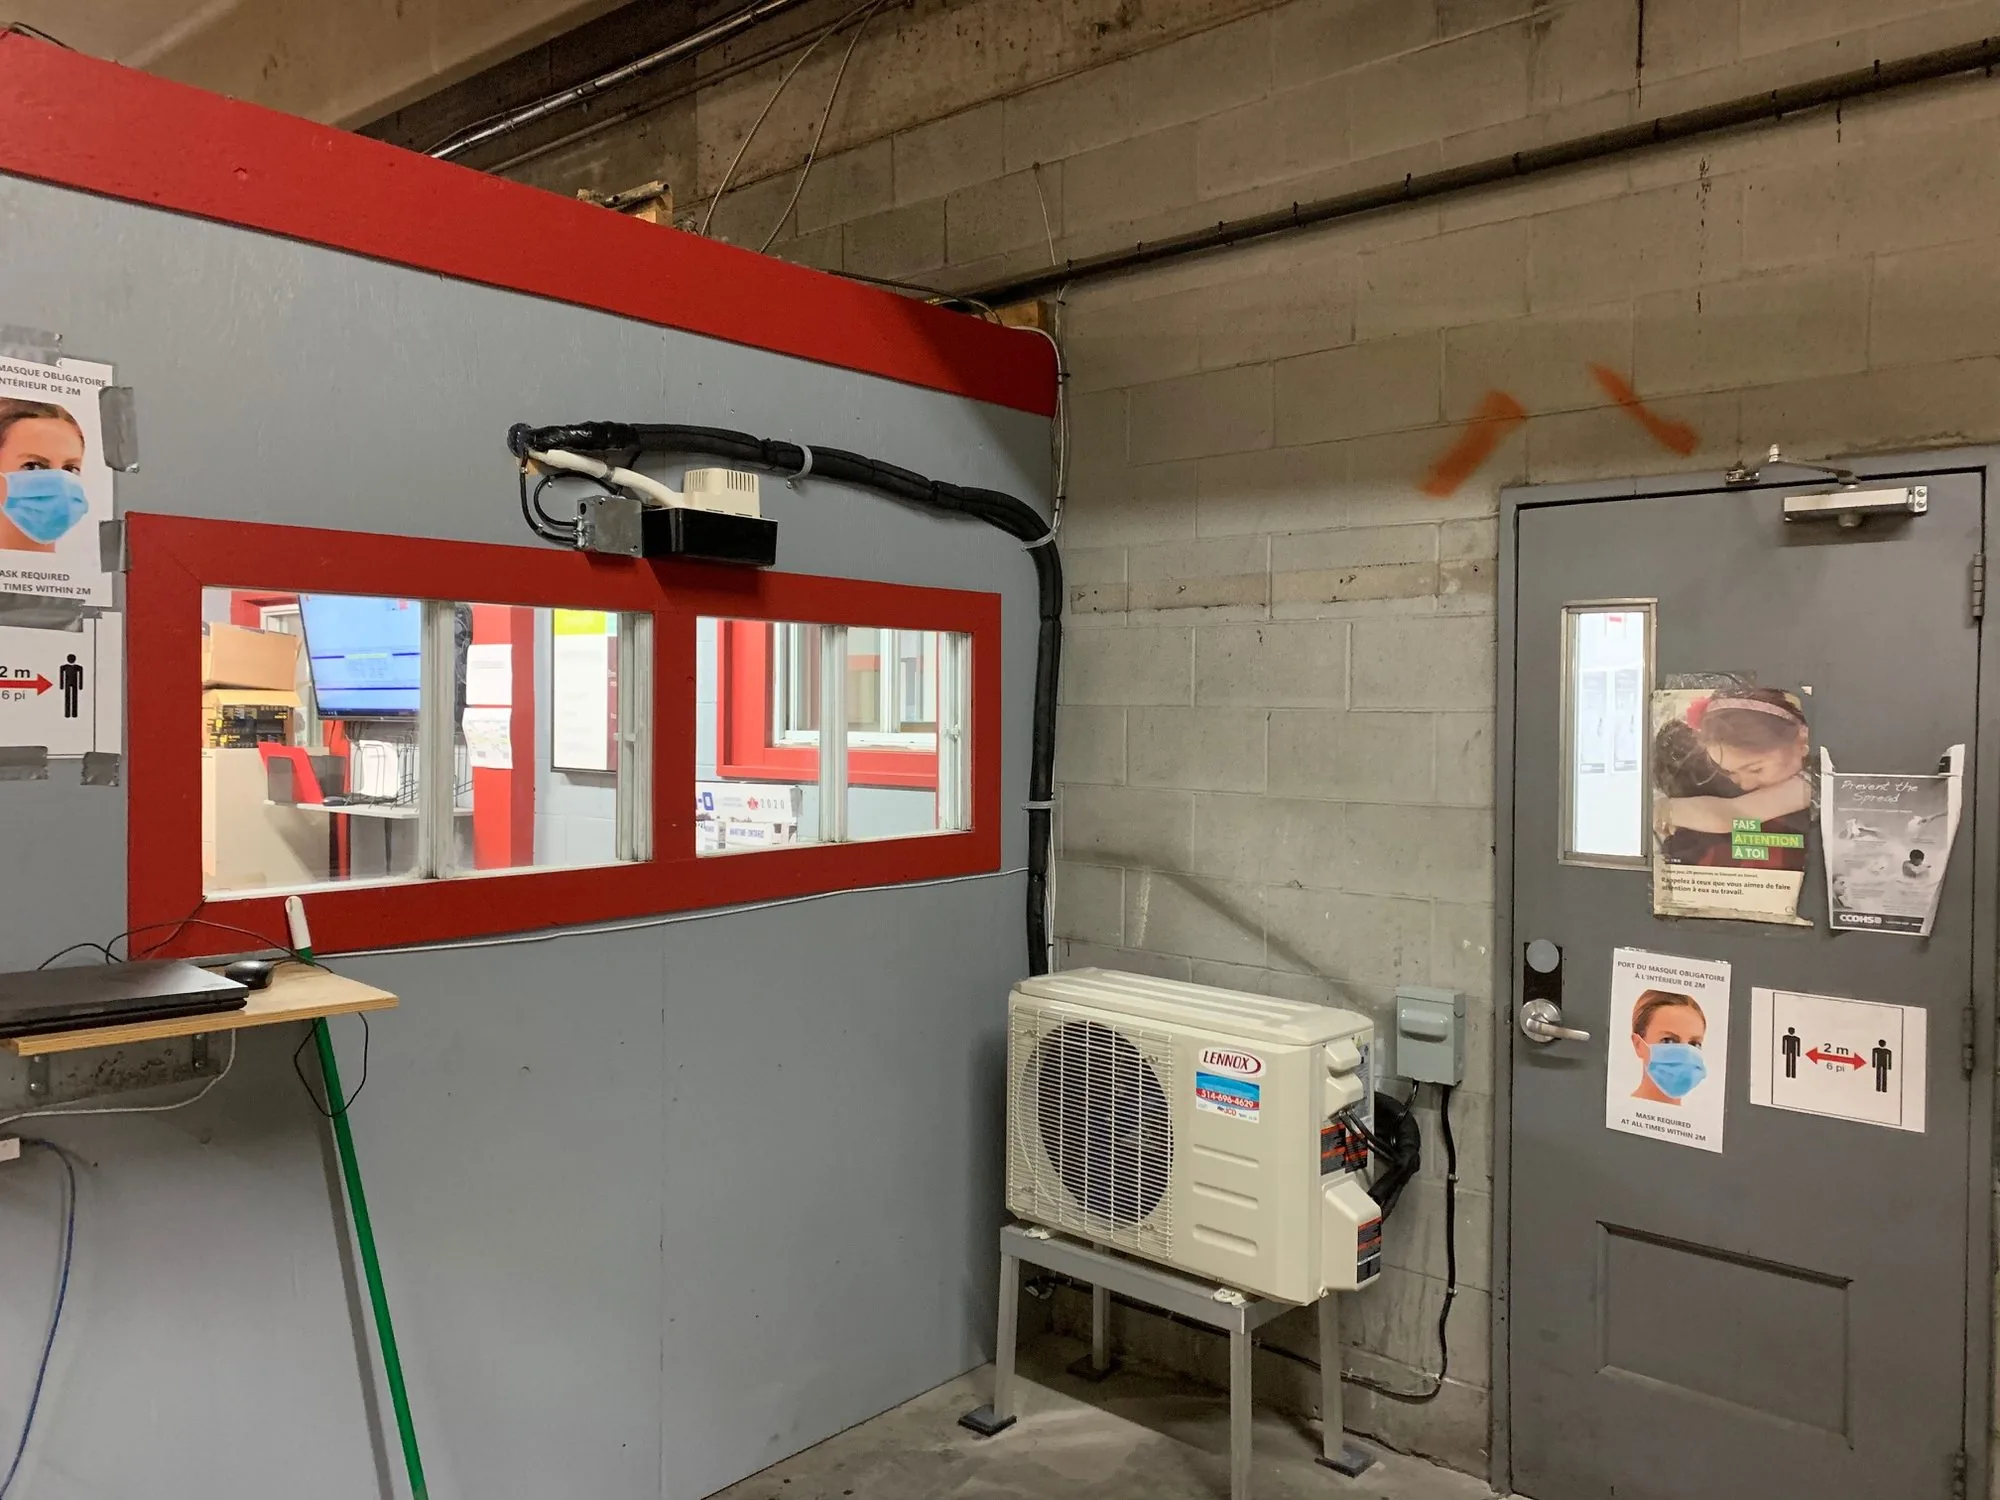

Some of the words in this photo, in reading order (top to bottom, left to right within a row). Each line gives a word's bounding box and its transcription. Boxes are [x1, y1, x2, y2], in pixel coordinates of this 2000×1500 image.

[0, 364, 40, 377] MASQUE
[43, 371, 106, 387] OBLIGATOIRE
[50, 385, 62, 394] DE
[66, 387, 81, 396] 2M
[21, 571, 70, 581] REQUIRED
[3, 583, 33, 592] TIMES
[36, 585, 73, 594] WITHIN
[76, 587, 91, 595] 2M
[0, 666, 8, 678] 2
[14, 669, 31, 678] m
[1, 690, 10, 700] 6
[14, 690, 26, 702] pi
[1841, 780, 1890, 791] Prevent
[1895, 781, 1918, 792] the
[1853, 791, 1900, 806] Spread
[1733, 820, 1756, 830] FAIS
[1735, 834, 1799, 847] ATTENTION
[1735, 847, 1743, 858] À
[1745, 848, 1765, 859] TOI
[1661, 877, 1690, 885] Rappelez
[1721, 888, 1744, 896] travail.
[1618, 960, 1635, 969] PORT
[1637, 963, 1647, 971] DU
[1649, 965, 1677, 975] MASQUE
[1679, 969, 1725, 982] OBLIGATOIRE
[1642, 973, 1682, 985] L'INTÉRIEUR
[1694, 981, 1706, 989] 2M
[1824, 1043, 1831, 1053] 2
[1836, 1047, 1849, 1055] m
[1203, 1050, 1249, 1071] LENNOX
[1826, 1062, 1833, 1070] 6
[1836, 1064, 1845, 1072] pi
[1636, 1112, 1656, 1121] MASK
[1657, 1116, 1691, 1129] REQUIRED
[1631, 1120, 1643, 1128] ALL
[1645, 1123, 1665, 1132] TIMES
[1667, 1128, 1693, 1140] WITHIN
